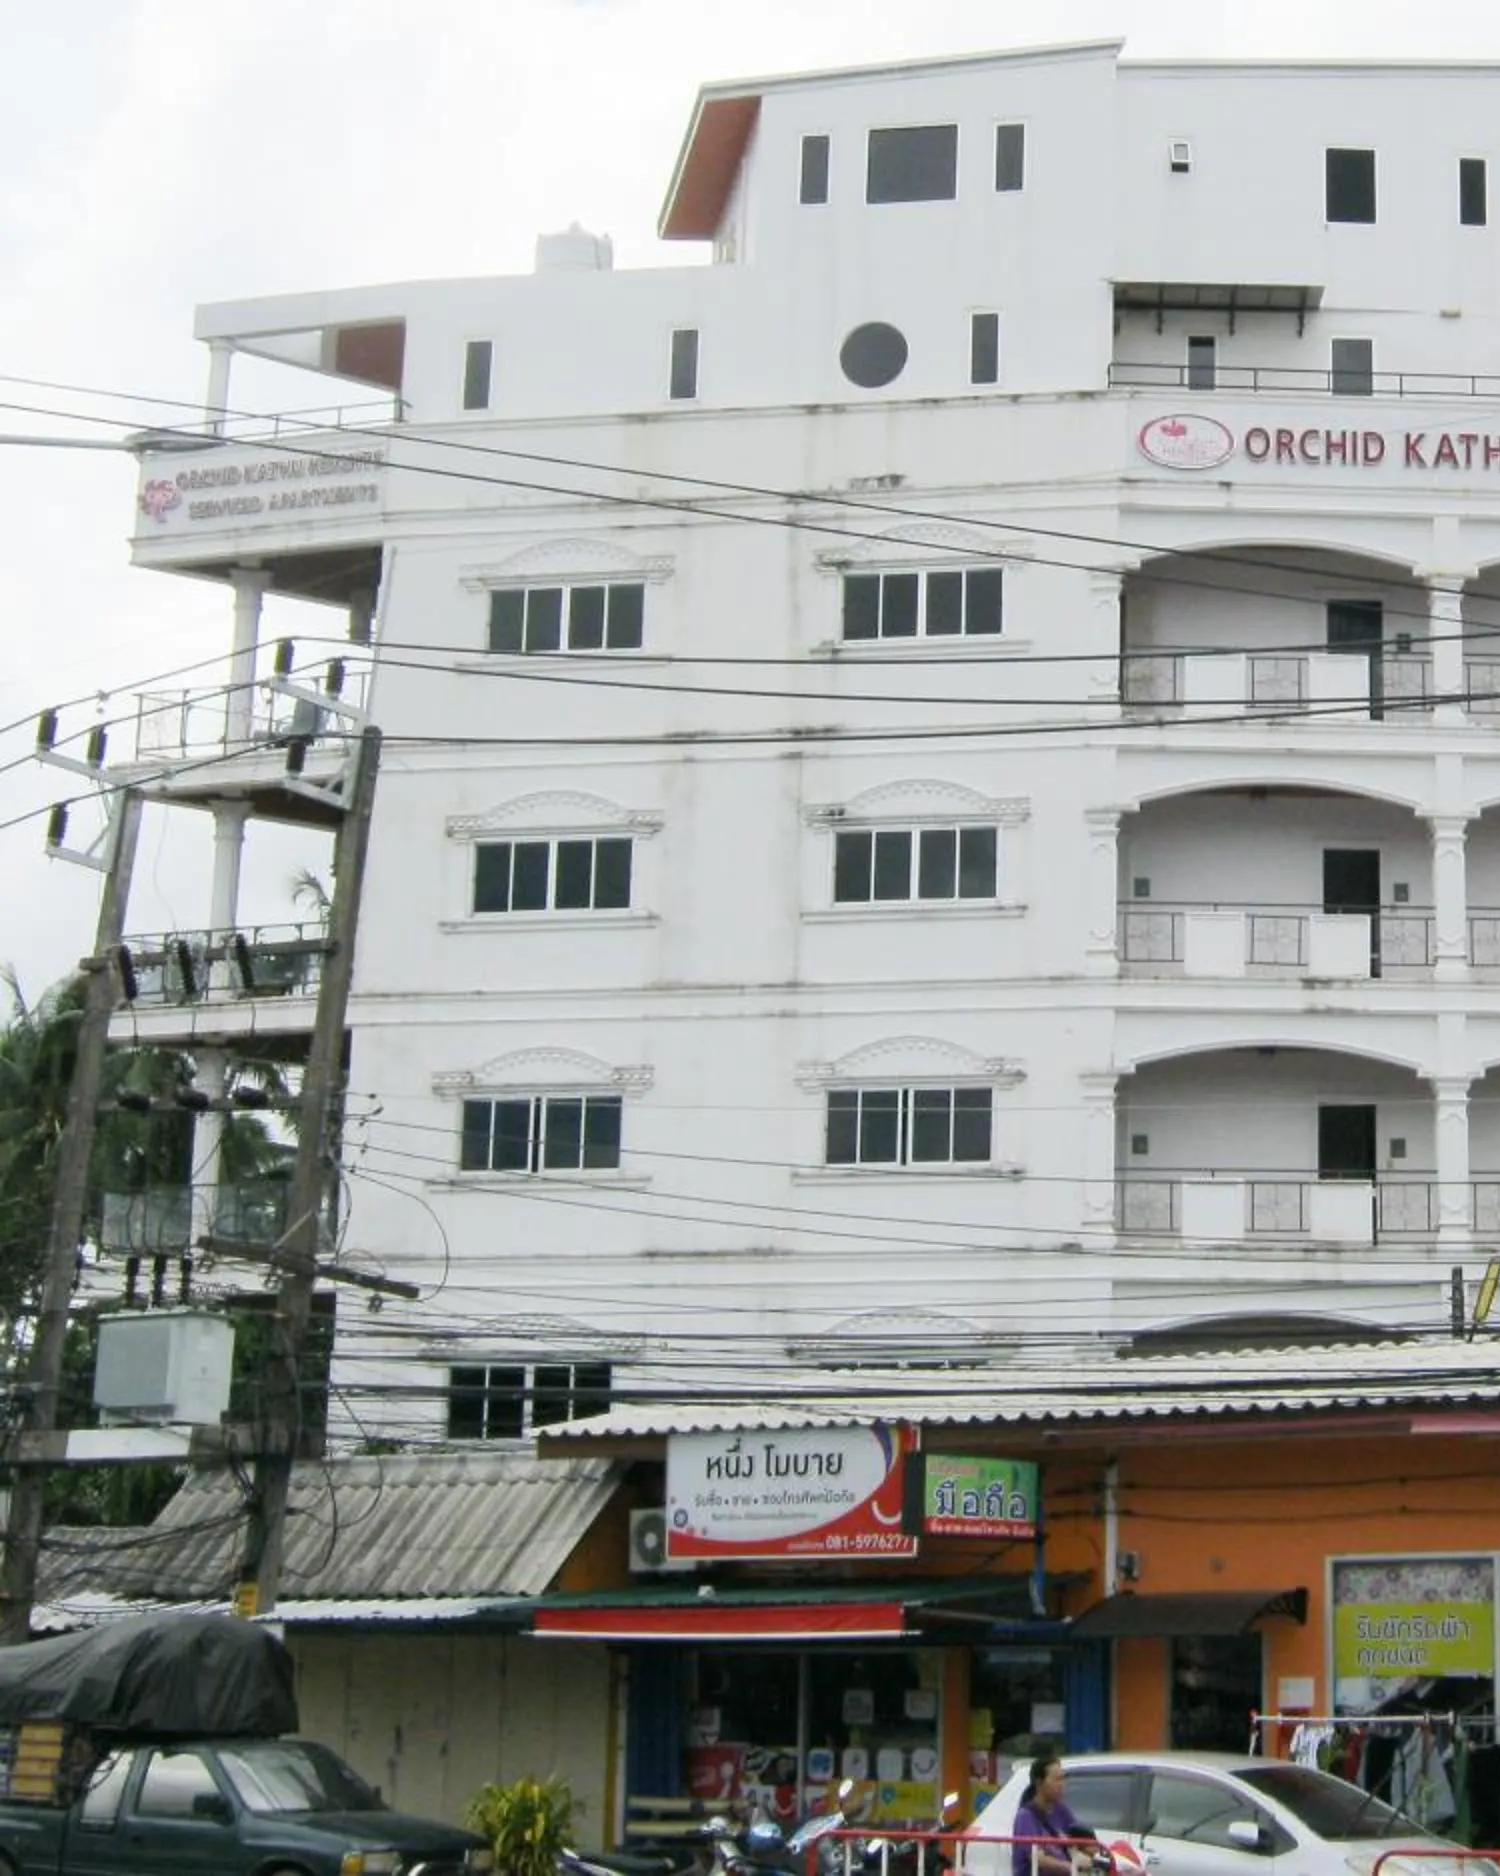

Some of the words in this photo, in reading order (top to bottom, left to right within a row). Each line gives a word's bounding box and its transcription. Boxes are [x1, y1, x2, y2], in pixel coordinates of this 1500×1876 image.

[1244, 427, 1386, 466] ORCHID
[706, 1438, 754, 1480] หนึ่ง
[765, 1444, 844, 1478] โมบาย
[935, 1478, 1028, 1520] มือถือ
